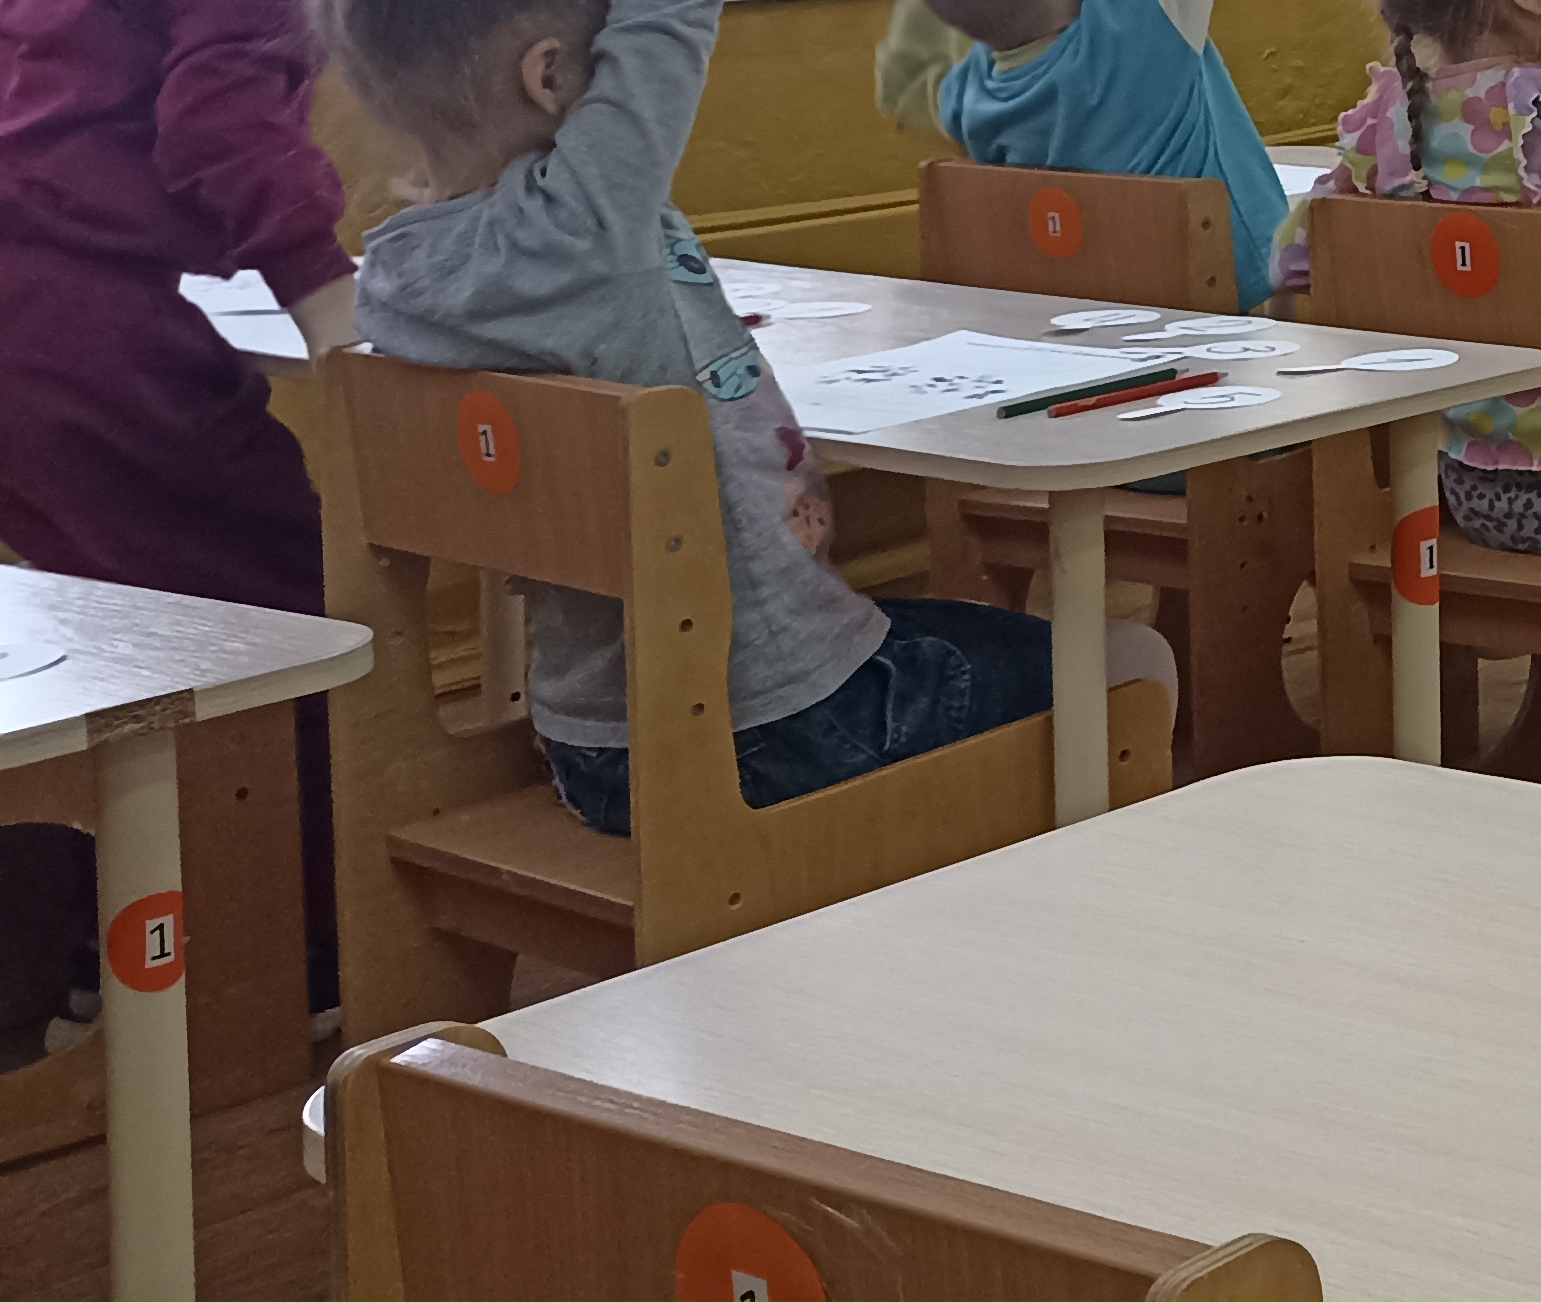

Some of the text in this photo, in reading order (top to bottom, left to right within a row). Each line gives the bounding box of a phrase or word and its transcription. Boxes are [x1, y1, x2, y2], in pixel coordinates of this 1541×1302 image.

[1048, 215, 1059, 234] 1
[1458, 245, 1467, 267] 1
[479, 429, 496, 458] 1
[1426, 543, 1435, 570] 1
[150, 922, 172, 961] 1
